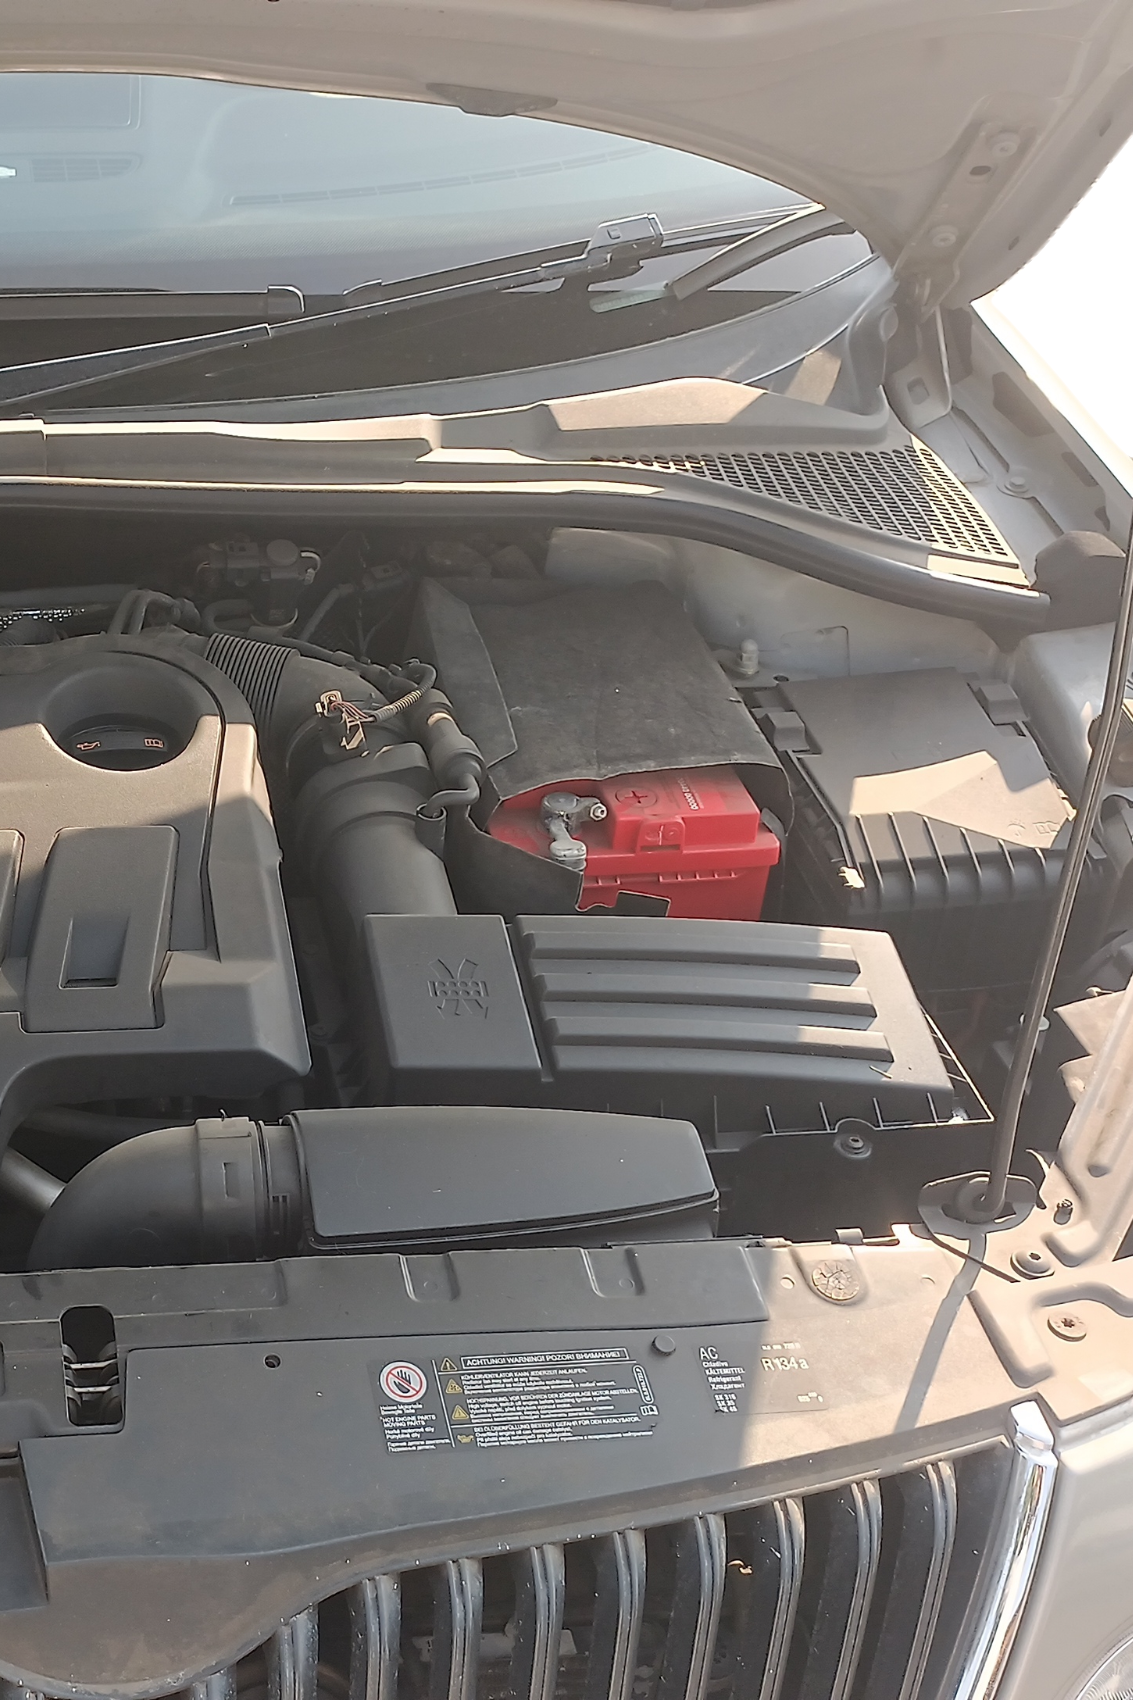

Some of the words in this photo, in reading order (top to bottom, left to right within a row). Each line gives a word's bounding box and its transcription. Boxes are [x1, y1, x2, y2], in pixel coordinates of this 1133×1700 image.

[699, 1346, 719, 1360] AC
[466, 1357, 506, 1366] ACHTUNG!
[506, 1355, 545, 1364] WARNING!
